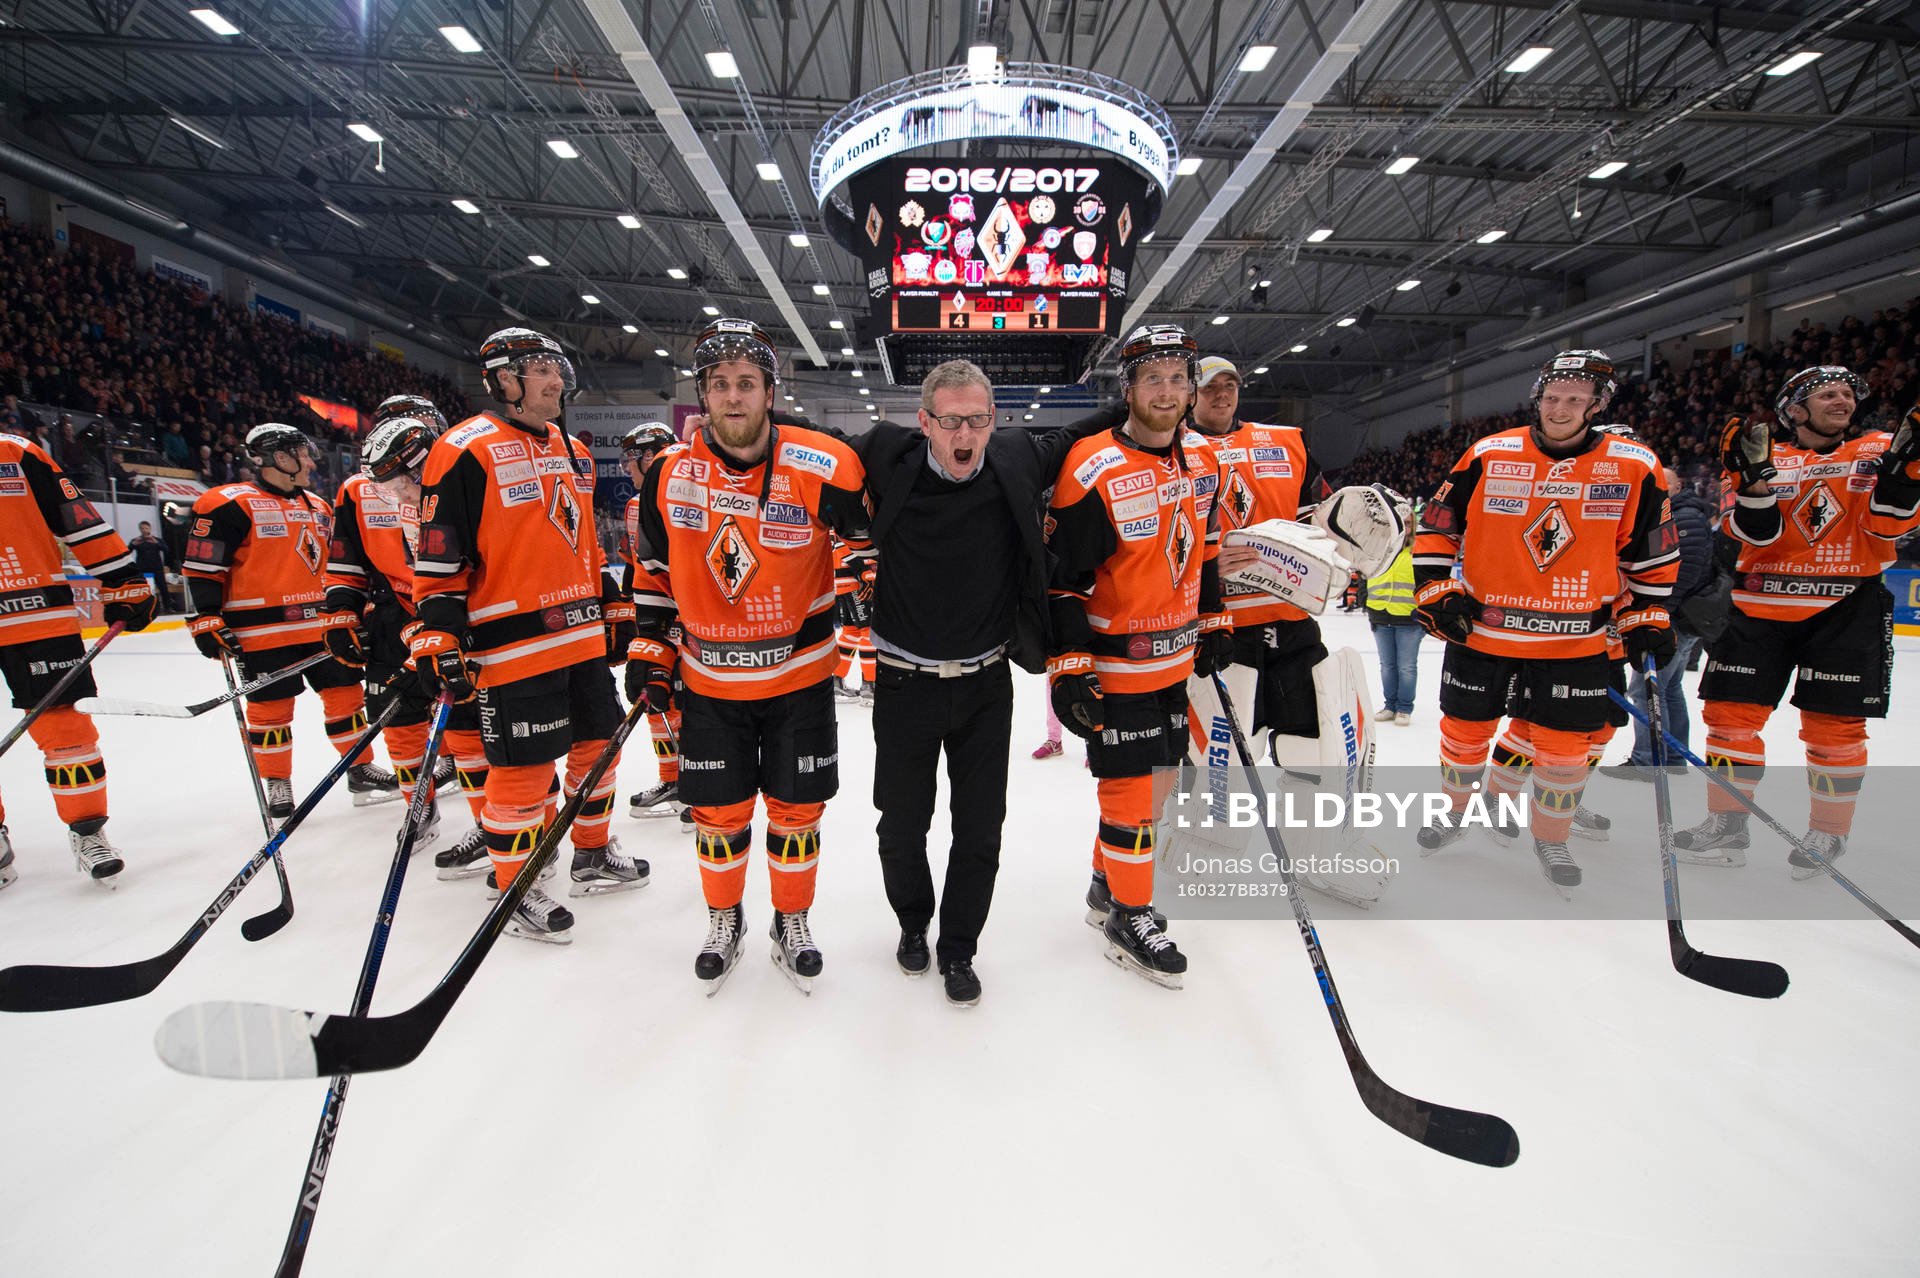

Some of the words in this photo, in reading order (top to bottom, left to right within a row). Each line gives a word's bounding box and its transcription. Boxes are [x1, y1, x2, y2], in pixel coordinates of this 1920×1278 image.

[847, 127, 890, 161] tomt?
[1129, 130, 1160, 166] Bygga
[905, 167, 1100, 193] 2016/2017
[868, 267, 887, 281] KARLS
[869, 275, 889, 289] KRONA
[975, 298, 1024, 311] 20:00
[953, 314, 965, 328] 4
[994, 317, 1003, 329] 3
[1033, 315, 1044, 328] 1
[575, 411, 602, 420] STÖRST
[604, 411, 614, 420] PÅ
[616, 412, 658, 420] BEGAGNAT!
[455, 430, 478, 446] Stena
[478, 423, 494, 434] Line
[495, 444, 524, 459] SAVE
[795, 449, 832, 469] STENA
[1623, 445, 1655, 462] STENA
[543, 459, 565, 473] jalas
[1081, 462, 1105, 486] Stena
[1104, 454, 1124, 465] Line
[1493, 464, 1530, 476] SAVE
[1592, 467, 1619, 475] KRONA
[1806, 465, 1842, 478] jalas
[771, 474, 790, 483] ARLS
[1115, 474, 1153, 494] SAVE
[508, 482, 540, 499] BAGA
[770, 482, 791, 492] RONA
[1540, 484, 1575, 496] jalas
[1603, 485, 1630, 495] MCT
[713, 494, 752, 511] jalas
[1488, 498, 1523, 508] BAGA
[403, 508, 418, 517] SA
[778, 504, 807, 519] MCT
[368, 515, 397, 524] BAGA
[1123, 516, 1158, 534] BAGA
[261, 525, 285, 533] BAGA
[767, 530, 787, 539] AUDIO
[1247, 540, 1309, 576] Cityhallen
[1240, 571, 1294, 596] BAUER
[1286, 570, 1302, 586] ICA
[73, 587, 100, 601] ER
[101, 587, 150, 601] AUER
[1419, 582, 1464, 602] BAUE
[1763, 581, 1856, 597] BILCENTER
[0, 595, 47, 615] NTER
[1485, 593, 1593, 611] printfabriken
[605, 608, 637, 619] BAU
[1198, 616, 1234, 631] BAU
[1504, 615, 1591, 634] BILCENTER
[1153, 628, 1199, 656] BILCENTE
[701, 645, 793, 667] BILCENTER
[1814, 671, 1861, 683] Roxtec
[1571, 687, 1608, 697] Roxtec
[480, 706, 500, 743] Rock
[531, 717, 571, 734] Roxtec
[1120, 727, 1162, 742] Roxtec
[684, 759, 726, 770] Roxtec
[816, 753, 838, 768] Rox
[412, 778, 430, 824] BAUER
[518, 817, 569, 897] BAUER
[203, 852, 268, 927] NEXUS
